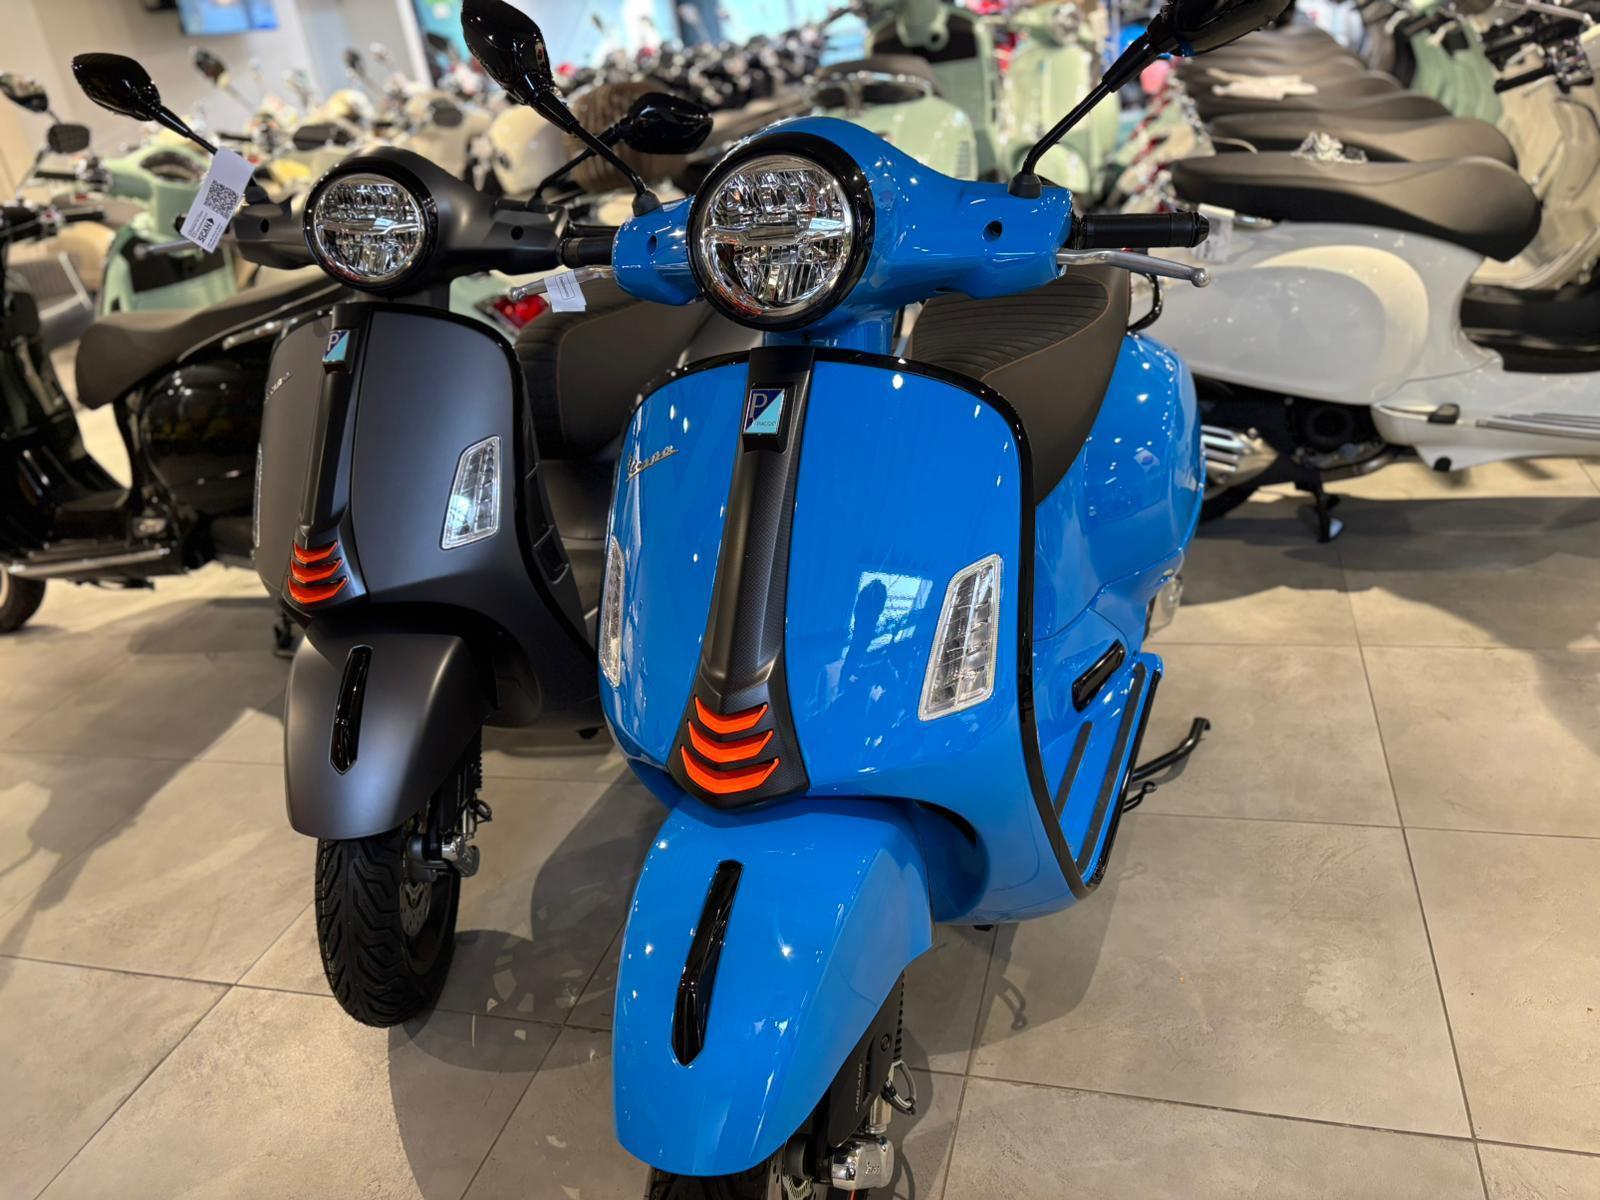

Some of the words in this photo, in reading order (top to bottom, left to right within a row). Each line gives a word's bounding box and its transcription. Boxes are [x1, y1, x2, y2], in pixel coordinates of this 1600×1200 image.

[197, 221, 212, 243] SCAN
[327, 333, 340, 352] P
[749, 393, 768, 418] P
[625, 445, 679, 482] Vespa
